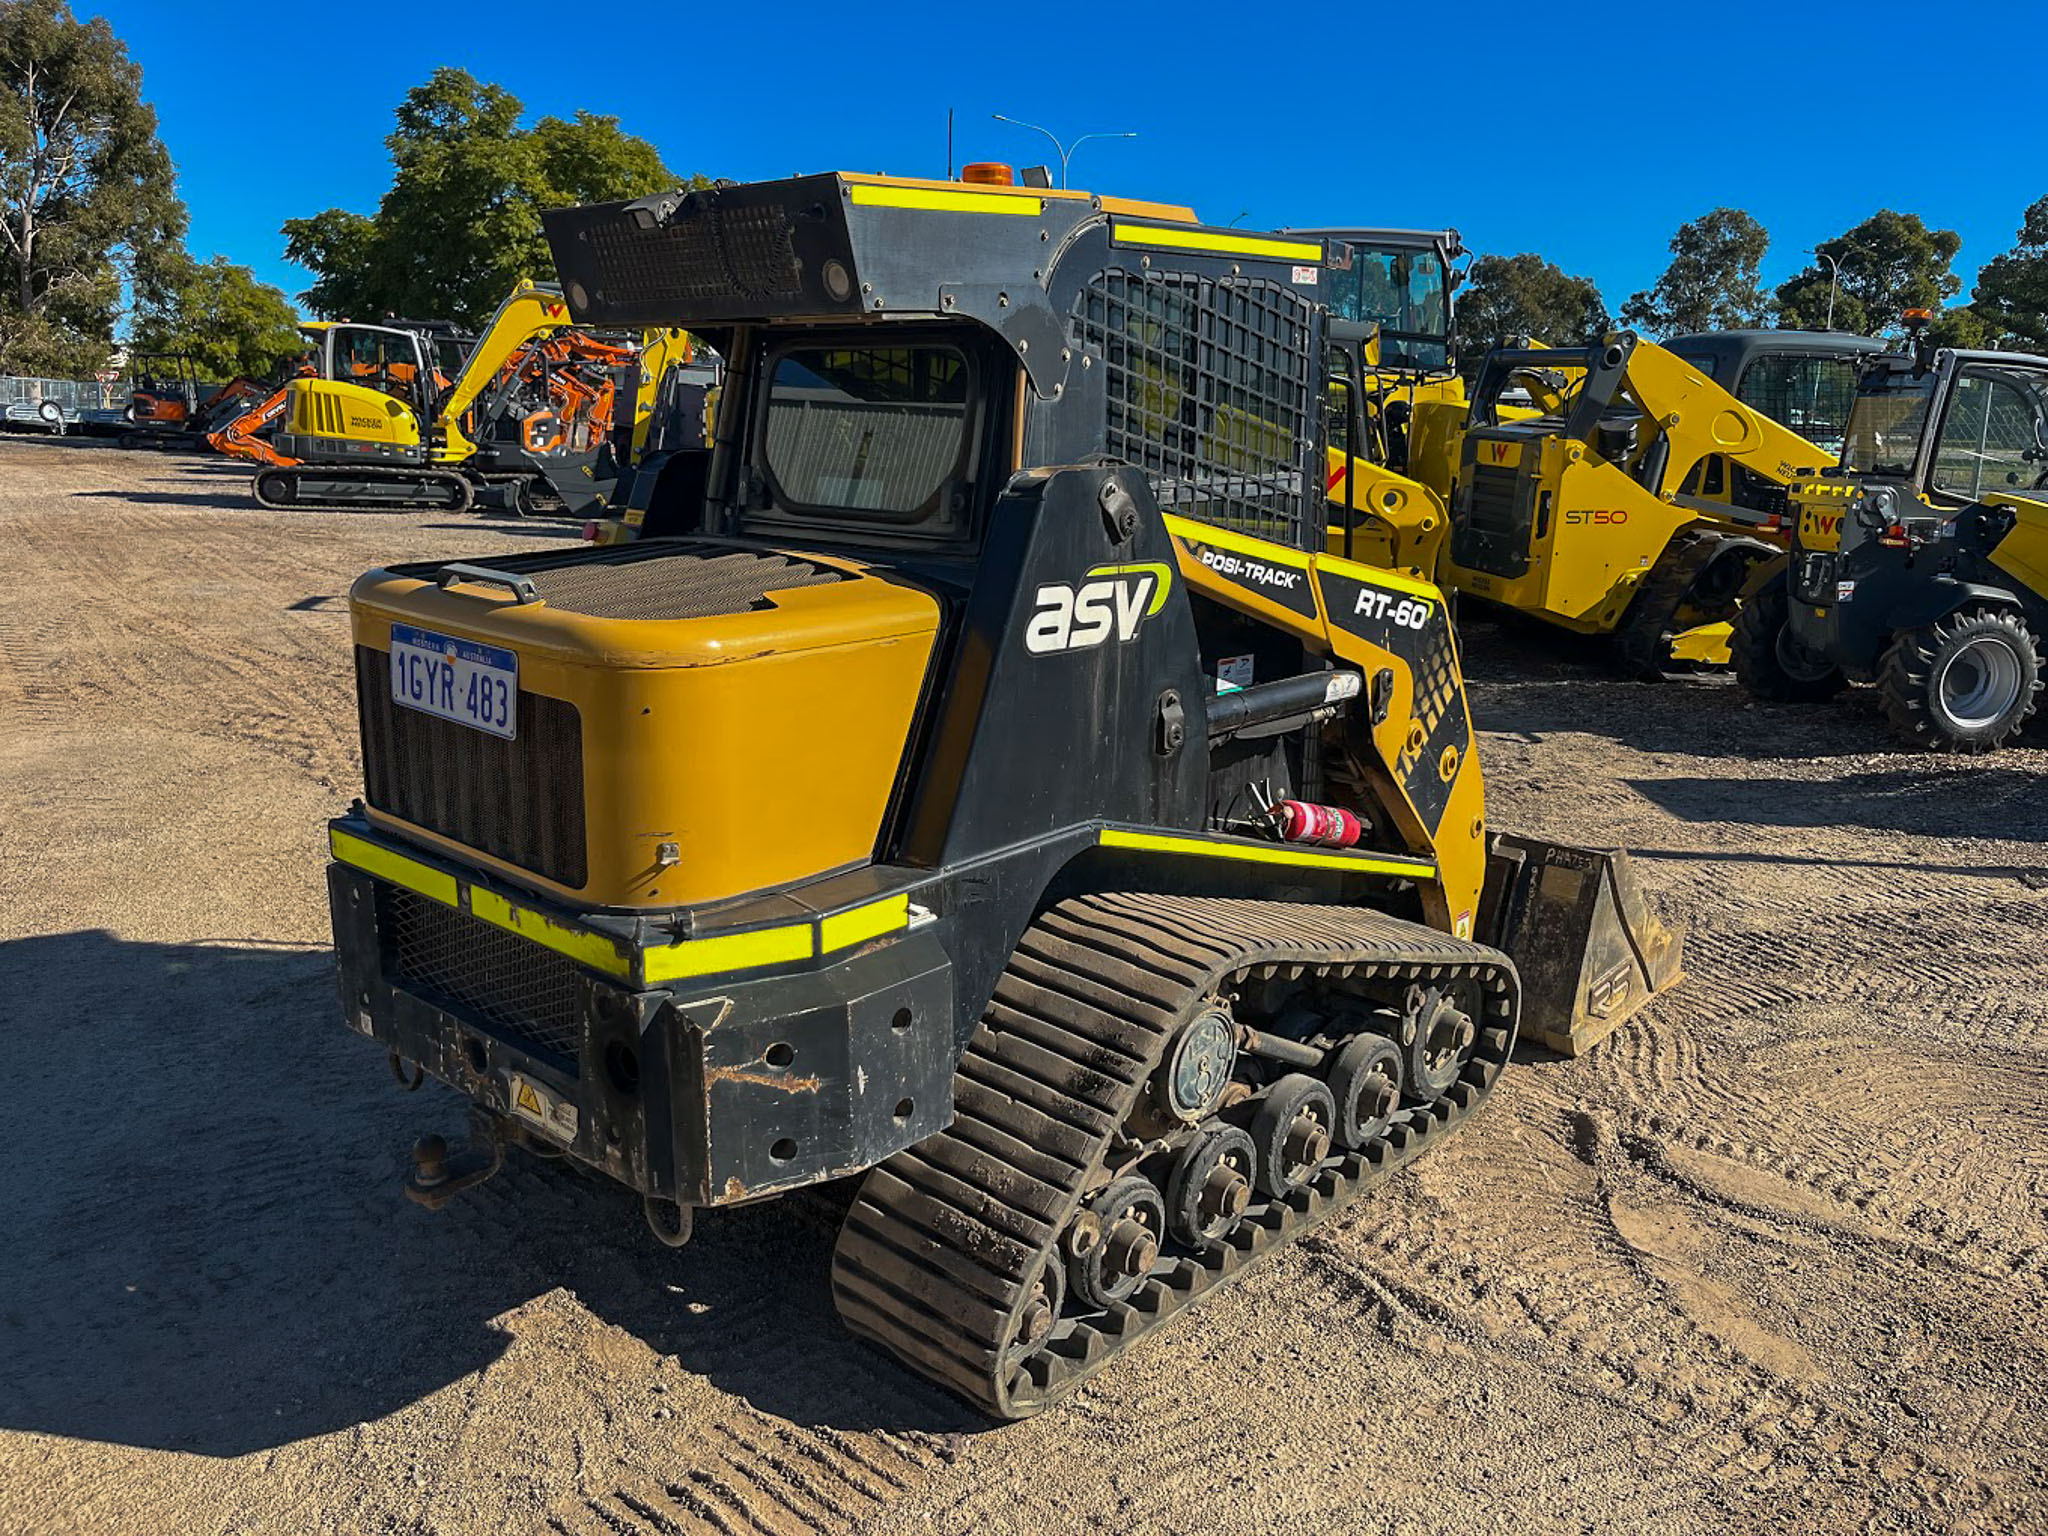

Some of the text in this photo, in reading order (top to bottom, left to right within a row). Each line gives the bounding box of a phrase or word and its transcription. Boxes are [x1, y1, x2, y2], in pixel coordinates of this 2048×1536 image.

[1565, 510, 1628, 524] ST50
[1354, 588, 1428, 630] RT-60
[412, 638, 493, 665] WESTERN AUSTRALIA
[398, 650, 508, 728] 1GYR 483
